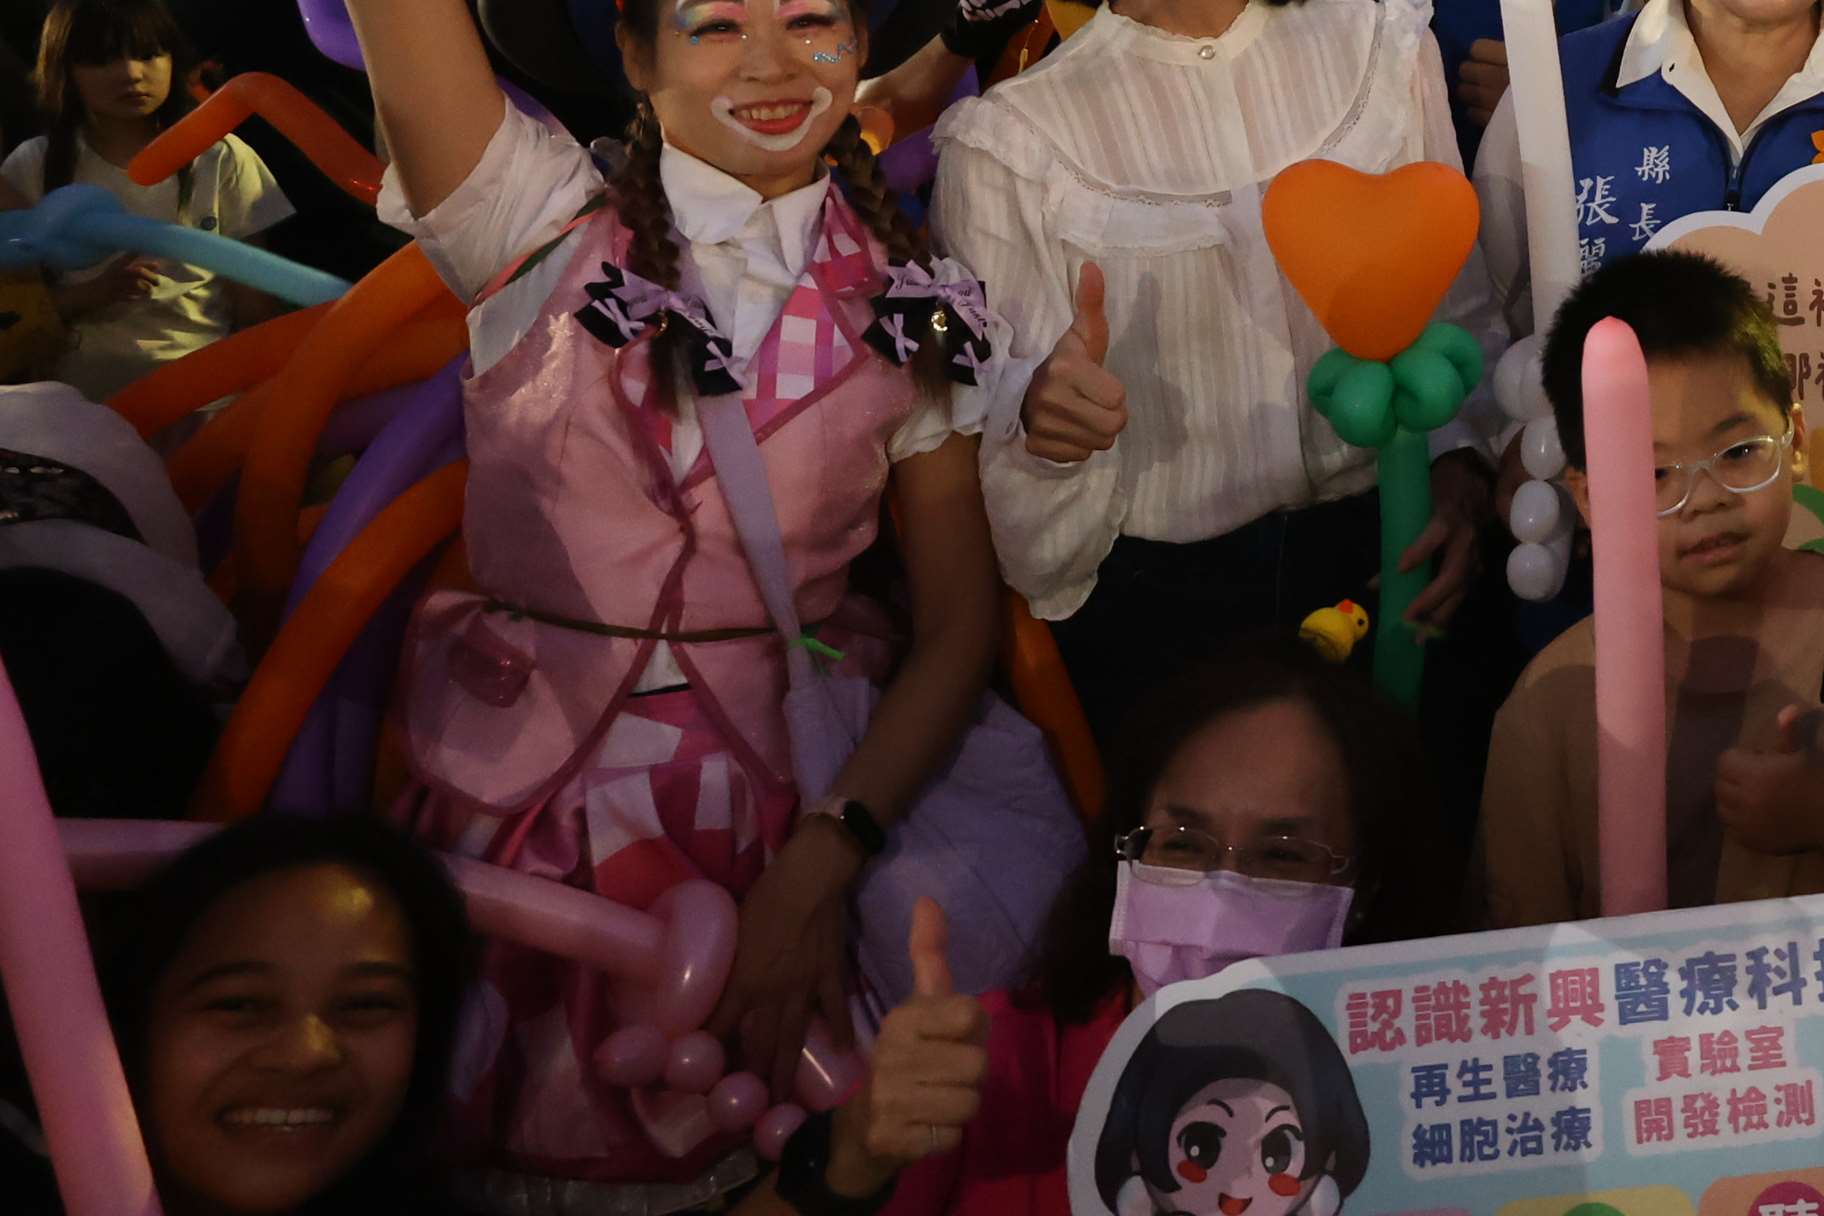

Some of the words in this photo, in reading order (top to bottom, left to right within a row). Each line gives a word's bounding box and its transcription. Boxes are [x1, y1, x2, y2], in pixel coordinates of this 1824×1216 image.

[1628, 145, 1671, 241] 縣長
[1410, 1046, 1589, 1109] 再生醫療
[1652, 1024, 1788, 1082] 實驗室
[1411, 1105, 1593, 1169] 細胞治療
[1633, 1079, 1816, 1145] 開發檢測
